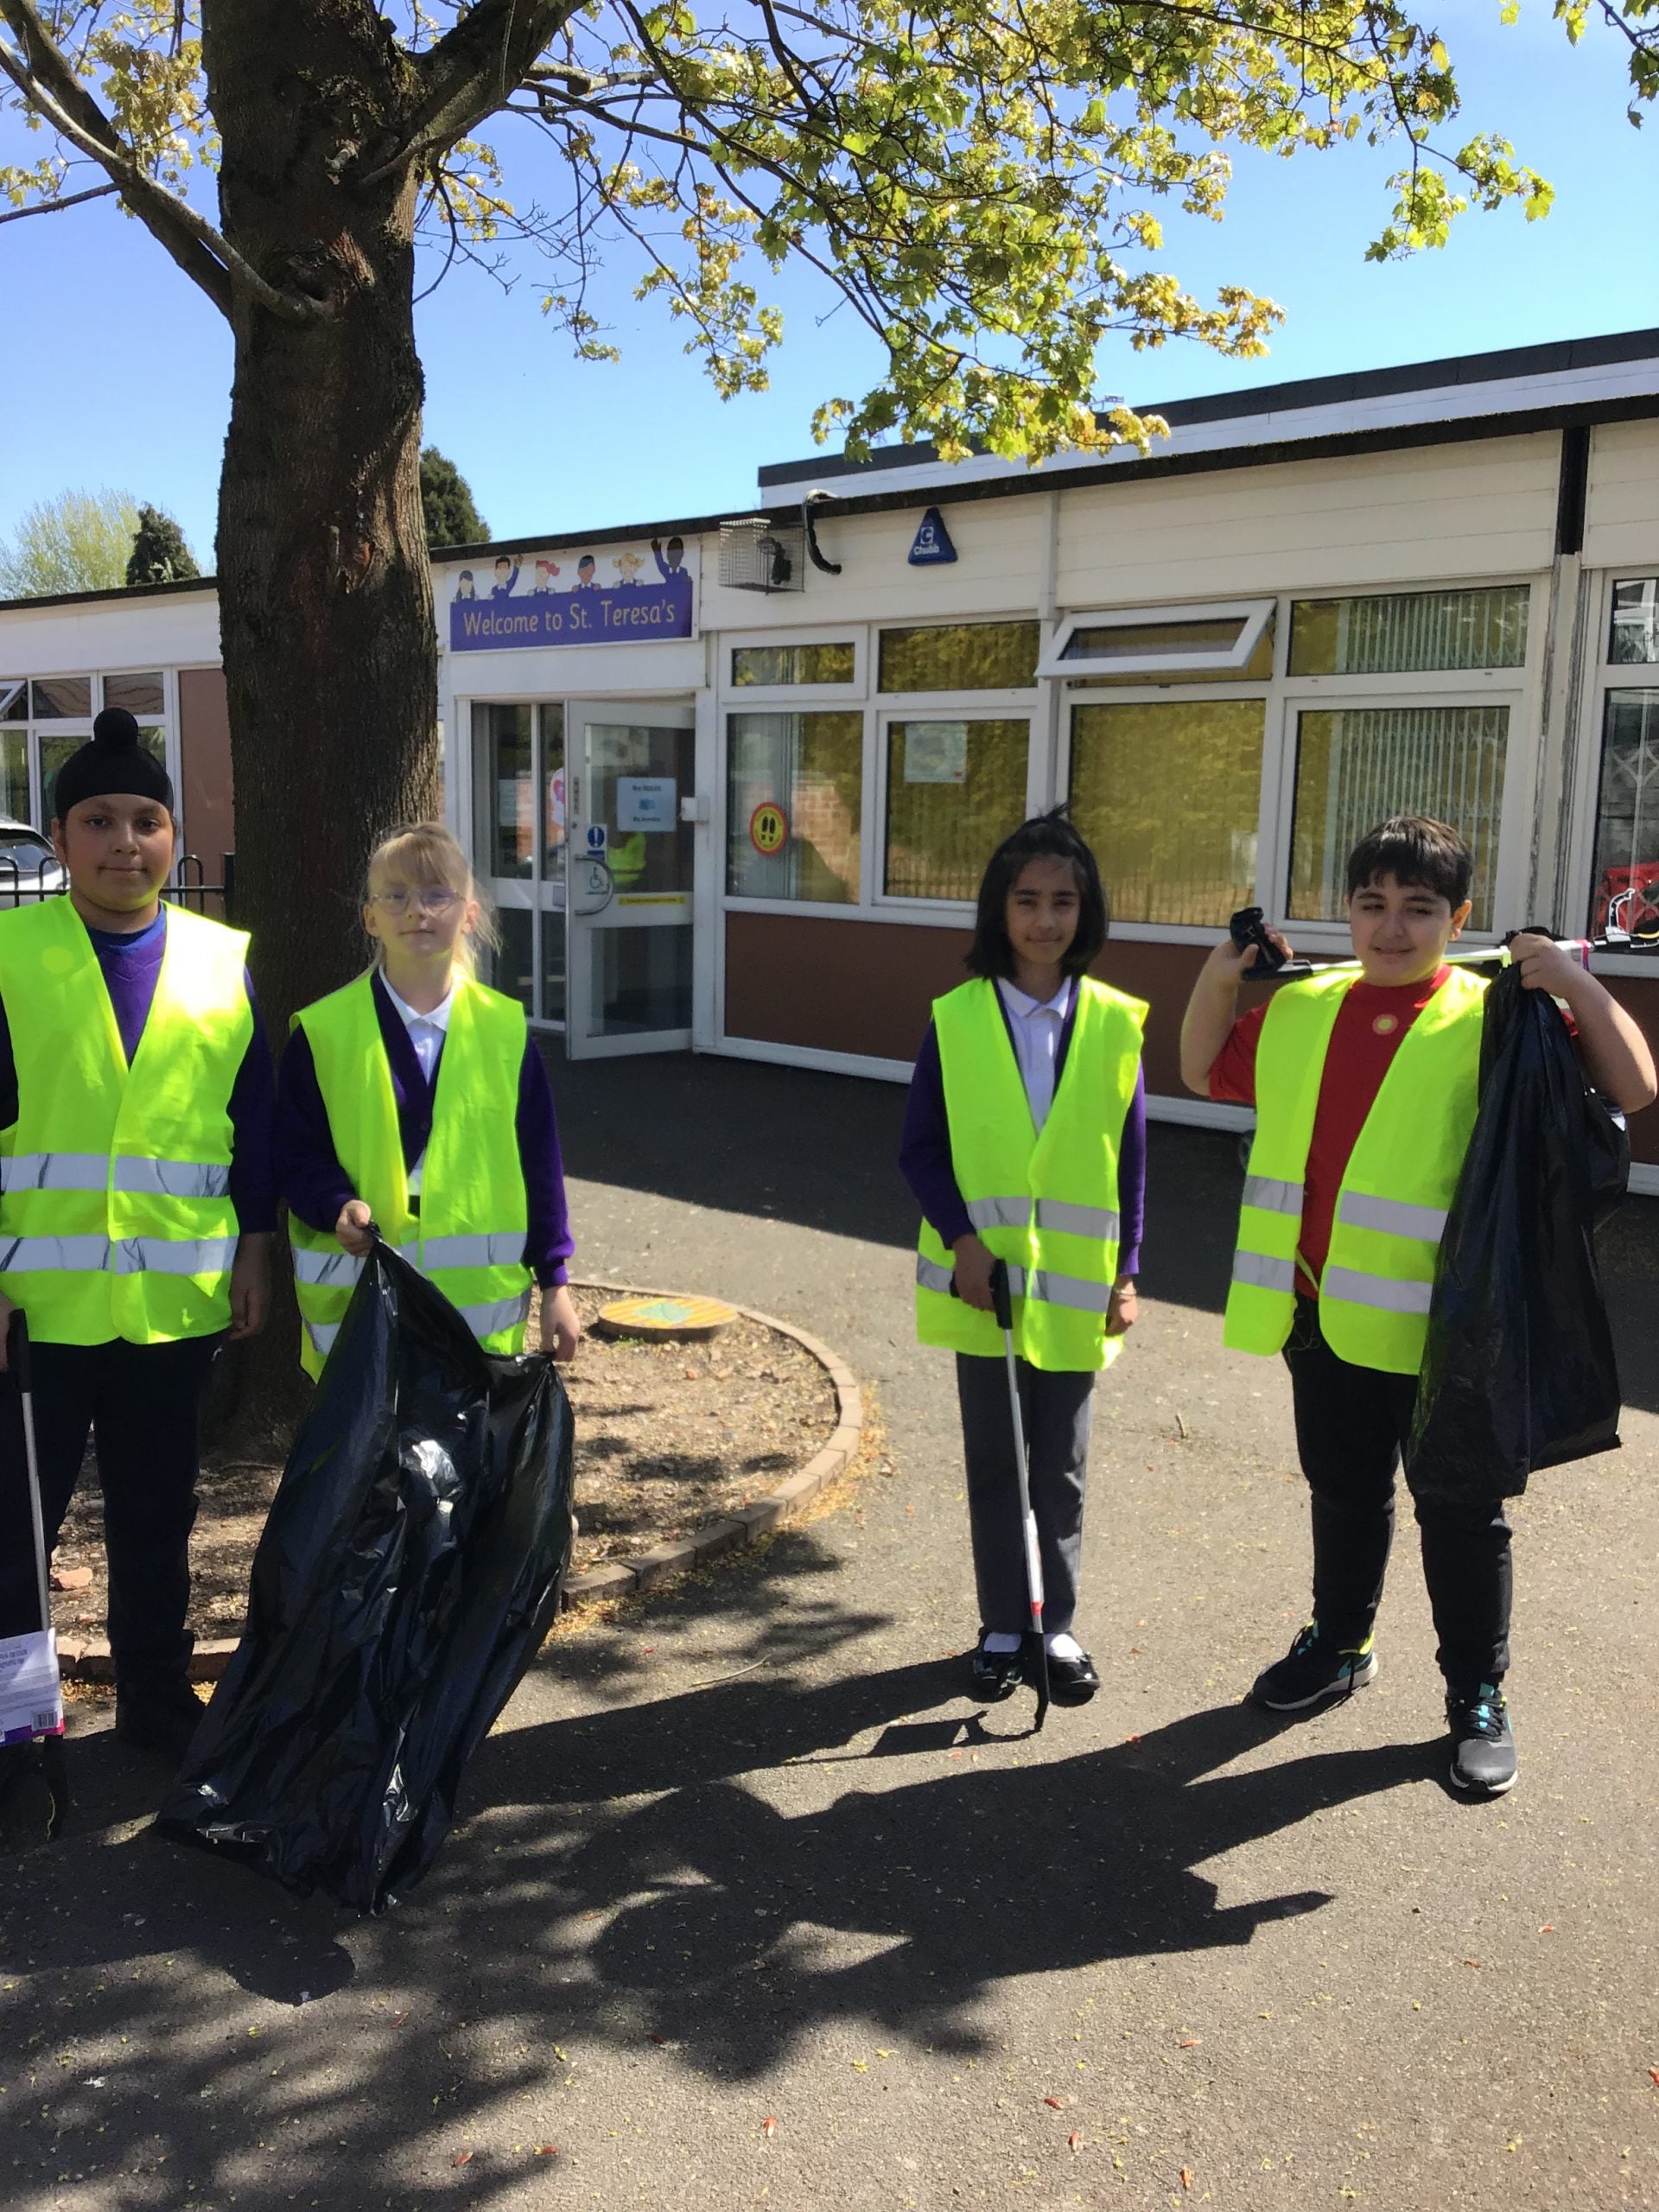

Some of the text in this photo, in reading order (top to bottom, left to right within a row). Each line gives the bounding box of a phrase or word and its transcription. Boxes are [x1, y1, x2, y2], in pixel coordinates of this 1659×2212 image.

[463, 599, 675, 636] Welcome to St. Teresa's
